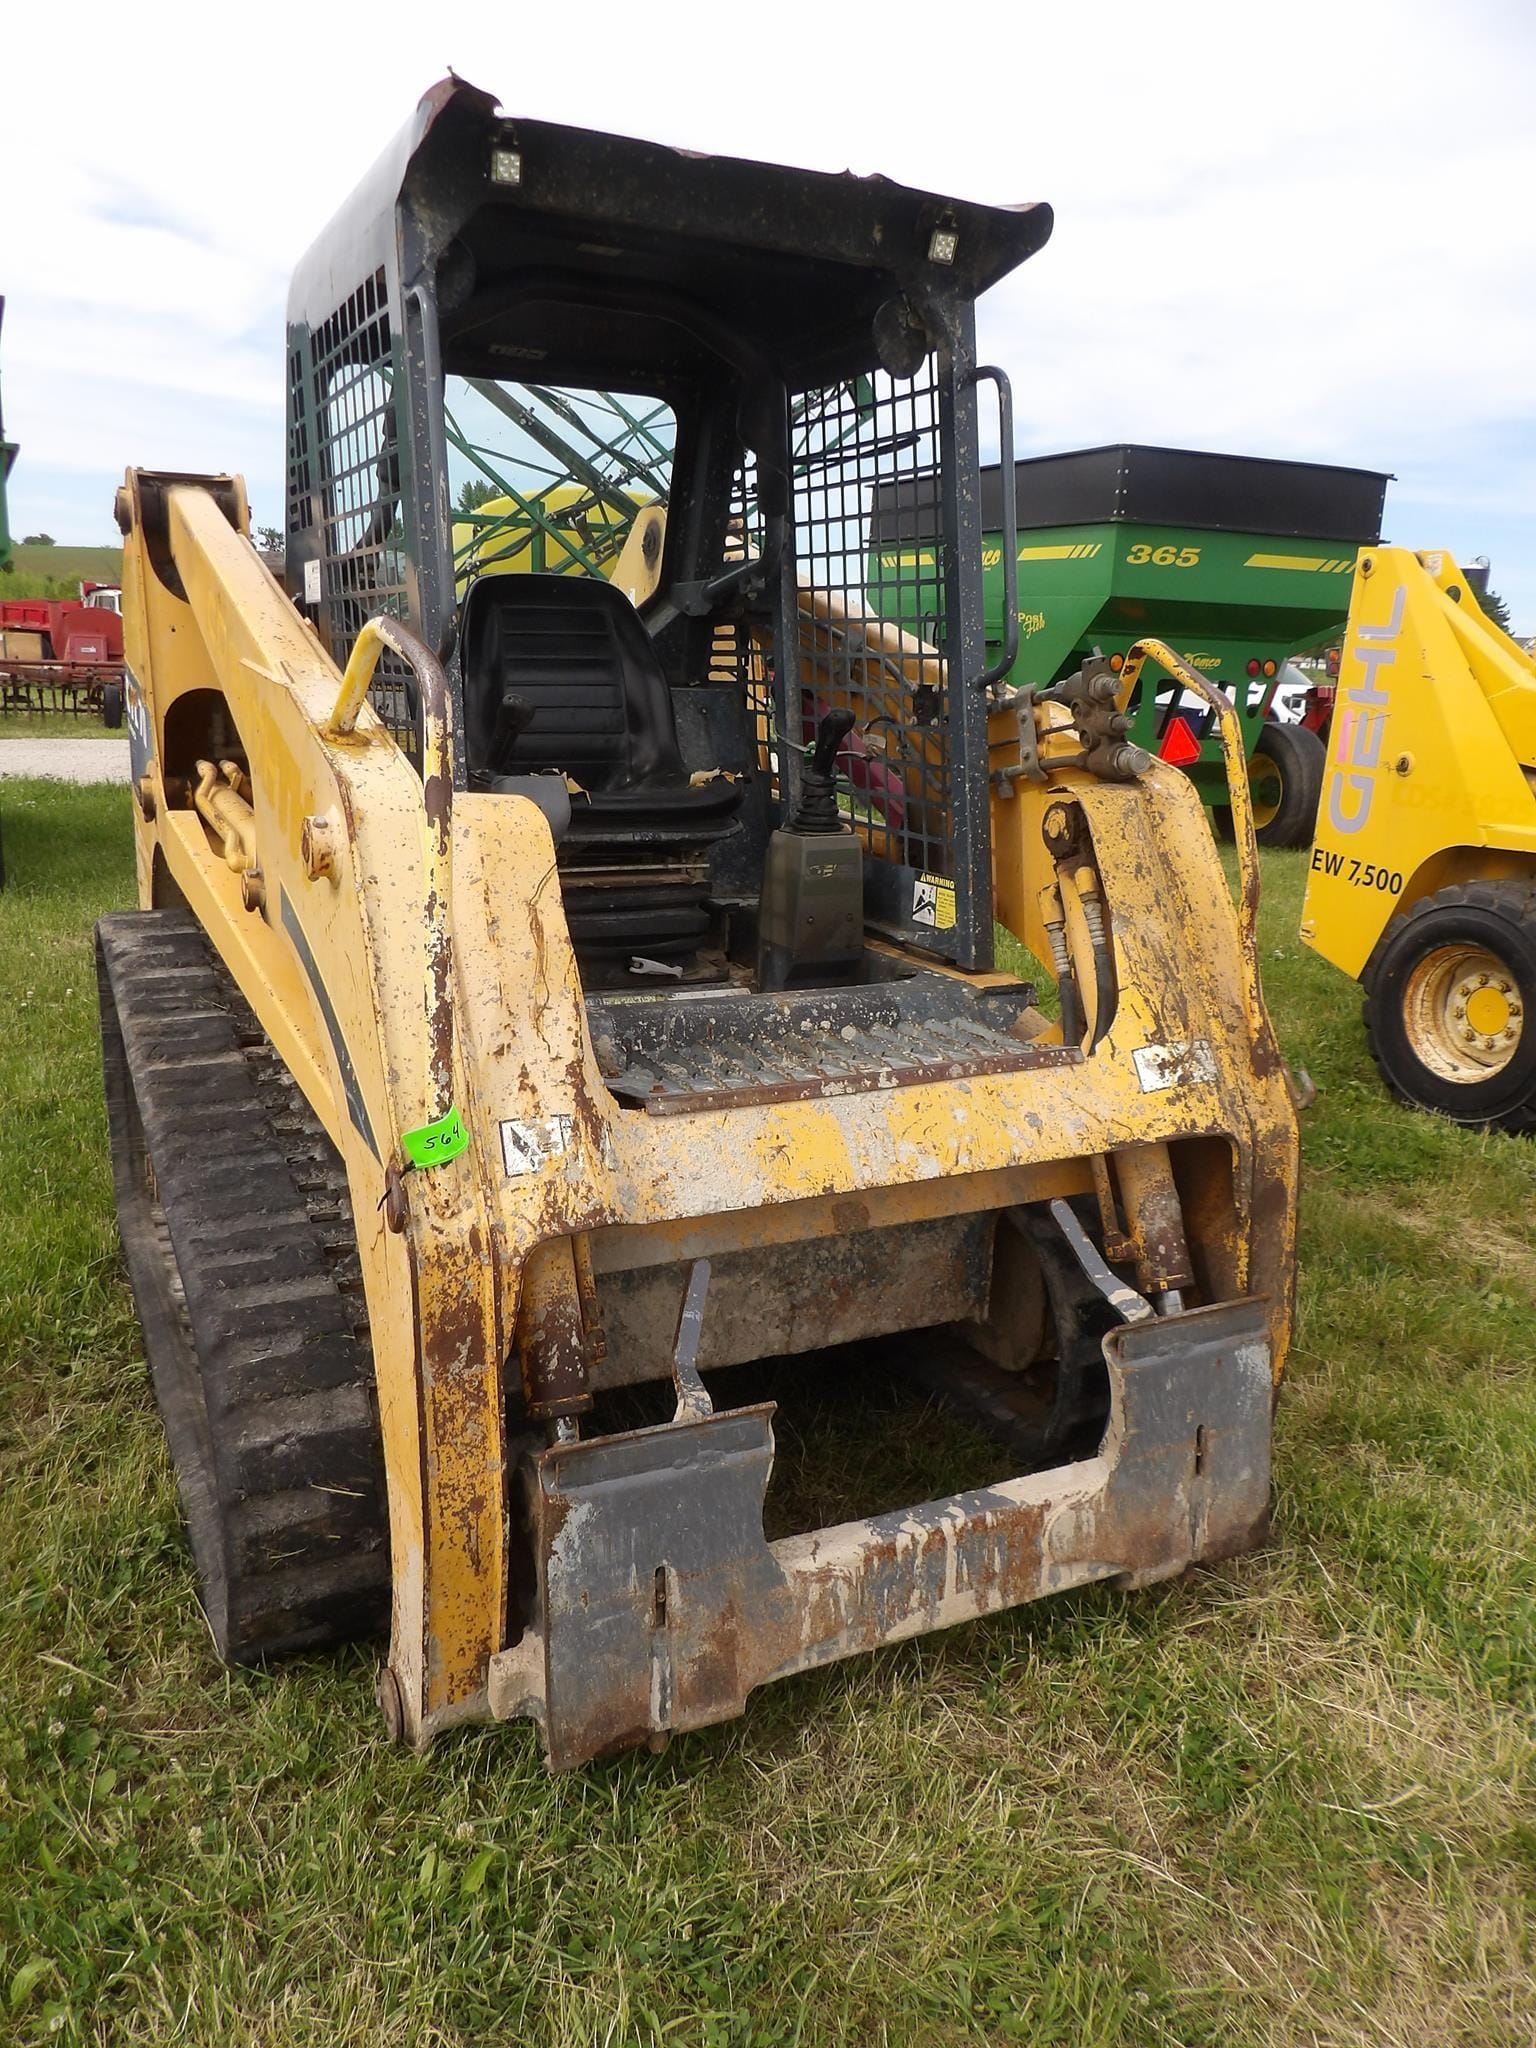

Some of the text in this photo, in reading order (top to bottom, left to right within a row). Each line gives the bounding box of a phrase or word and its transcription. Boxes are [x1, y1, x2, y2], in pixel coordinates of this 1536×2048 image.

[1126, 544, 1202, 568] 365
[1329, 585, 1407, 834] GEHL
[926, 874, 955, 889] WARNING
[1311, 848, 1403, 895] EW 7,500
[423, 1121, 460, 1149] 564
